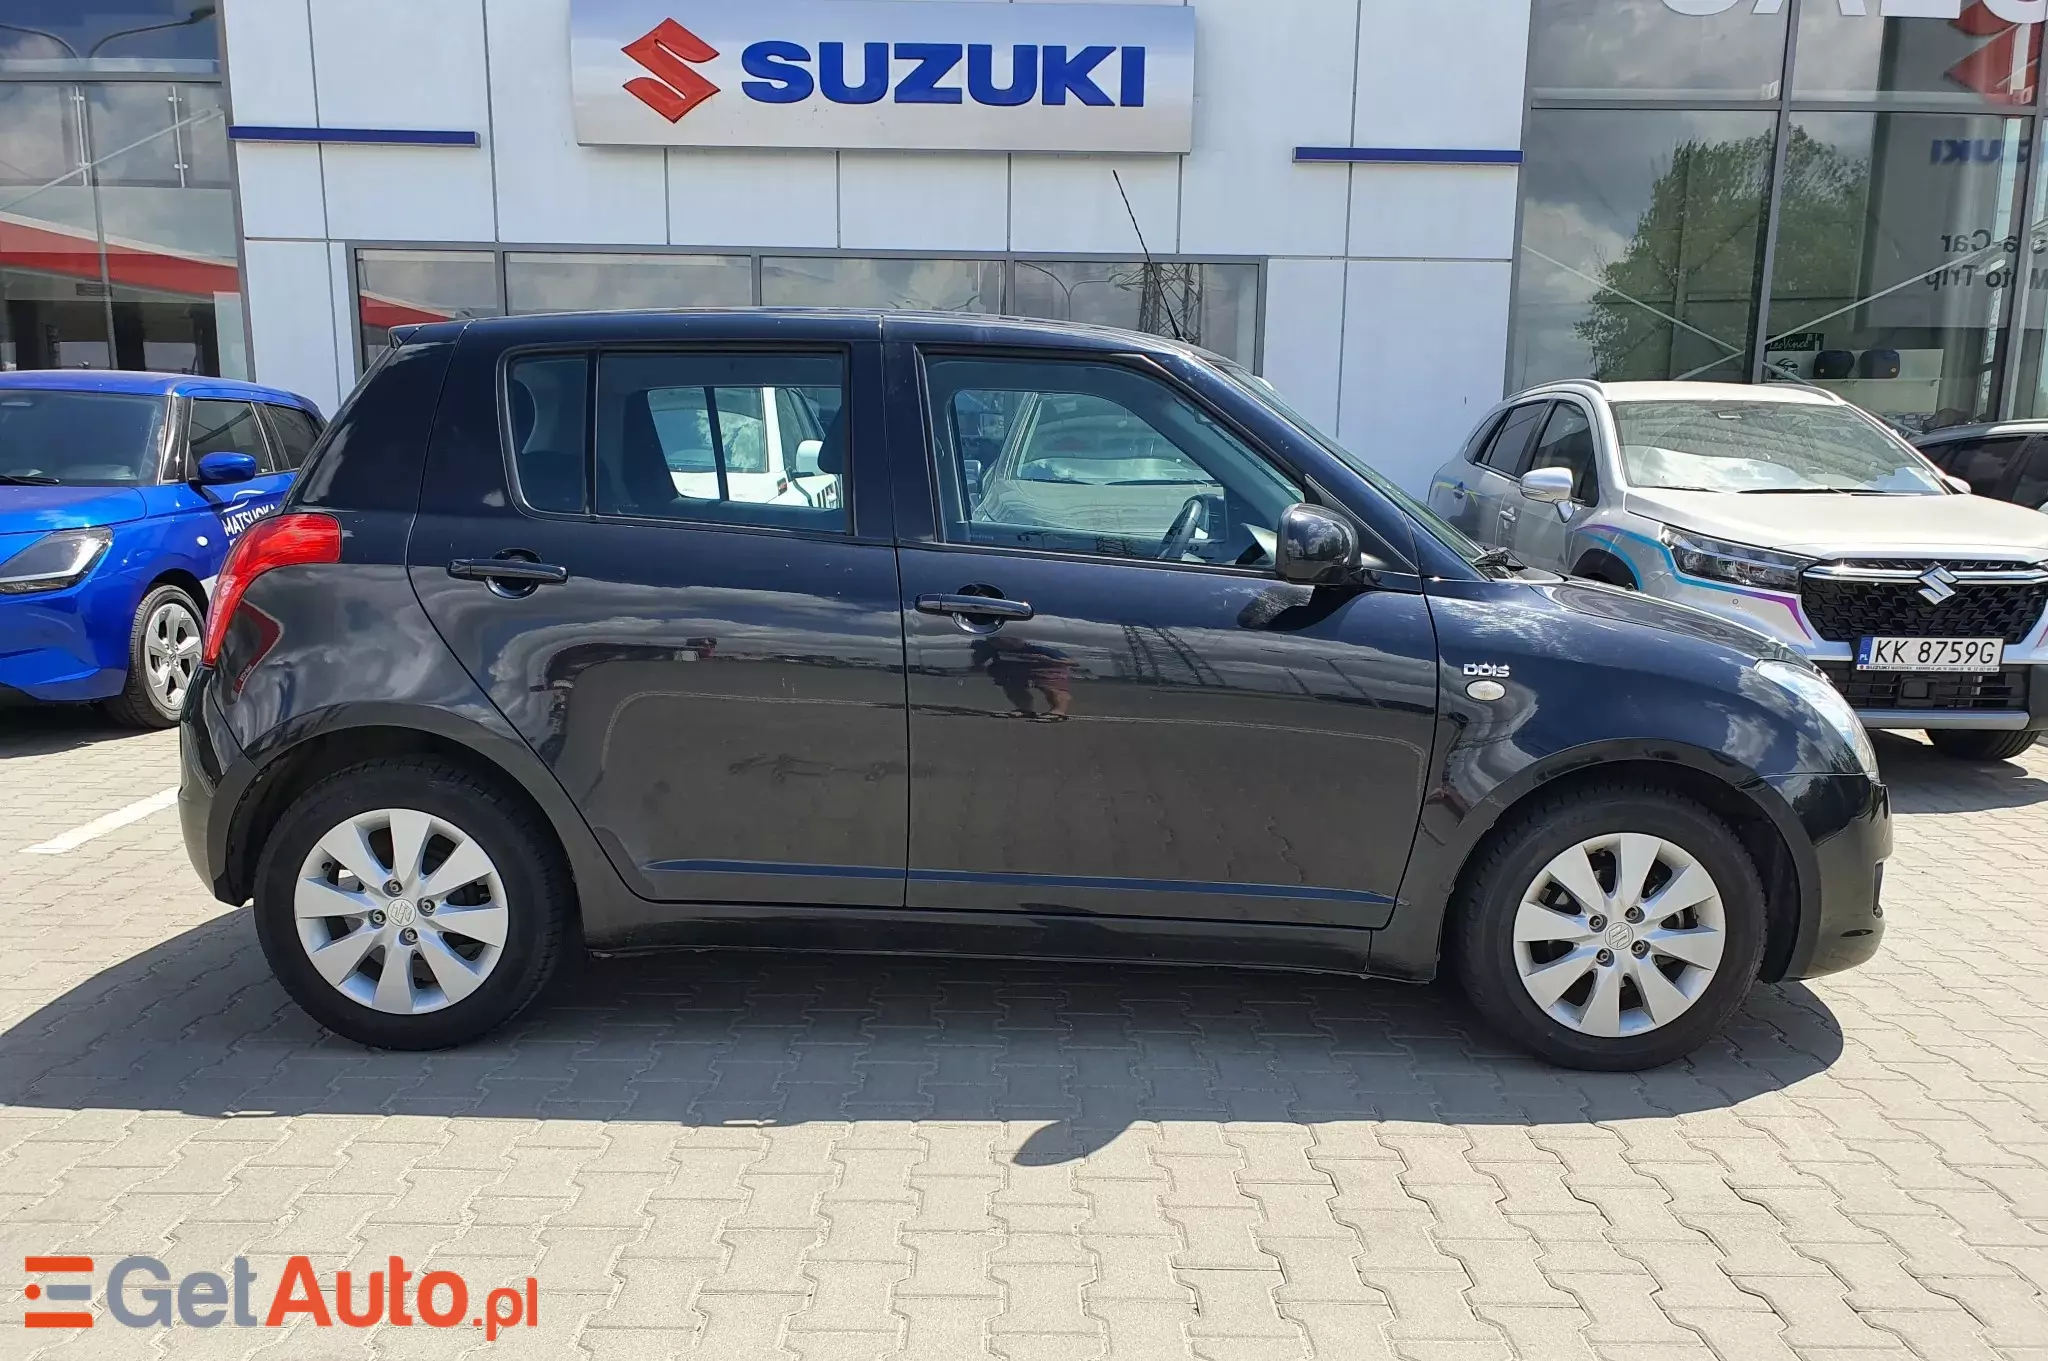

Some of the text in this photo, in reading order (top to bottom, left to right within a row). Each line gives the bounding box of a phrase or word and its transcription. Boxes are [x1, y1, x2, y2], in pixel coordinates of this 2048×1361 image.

[741, 40, 1146, 108] SUZUKI
[1875, 640, 1996, 664] KK 8759G
